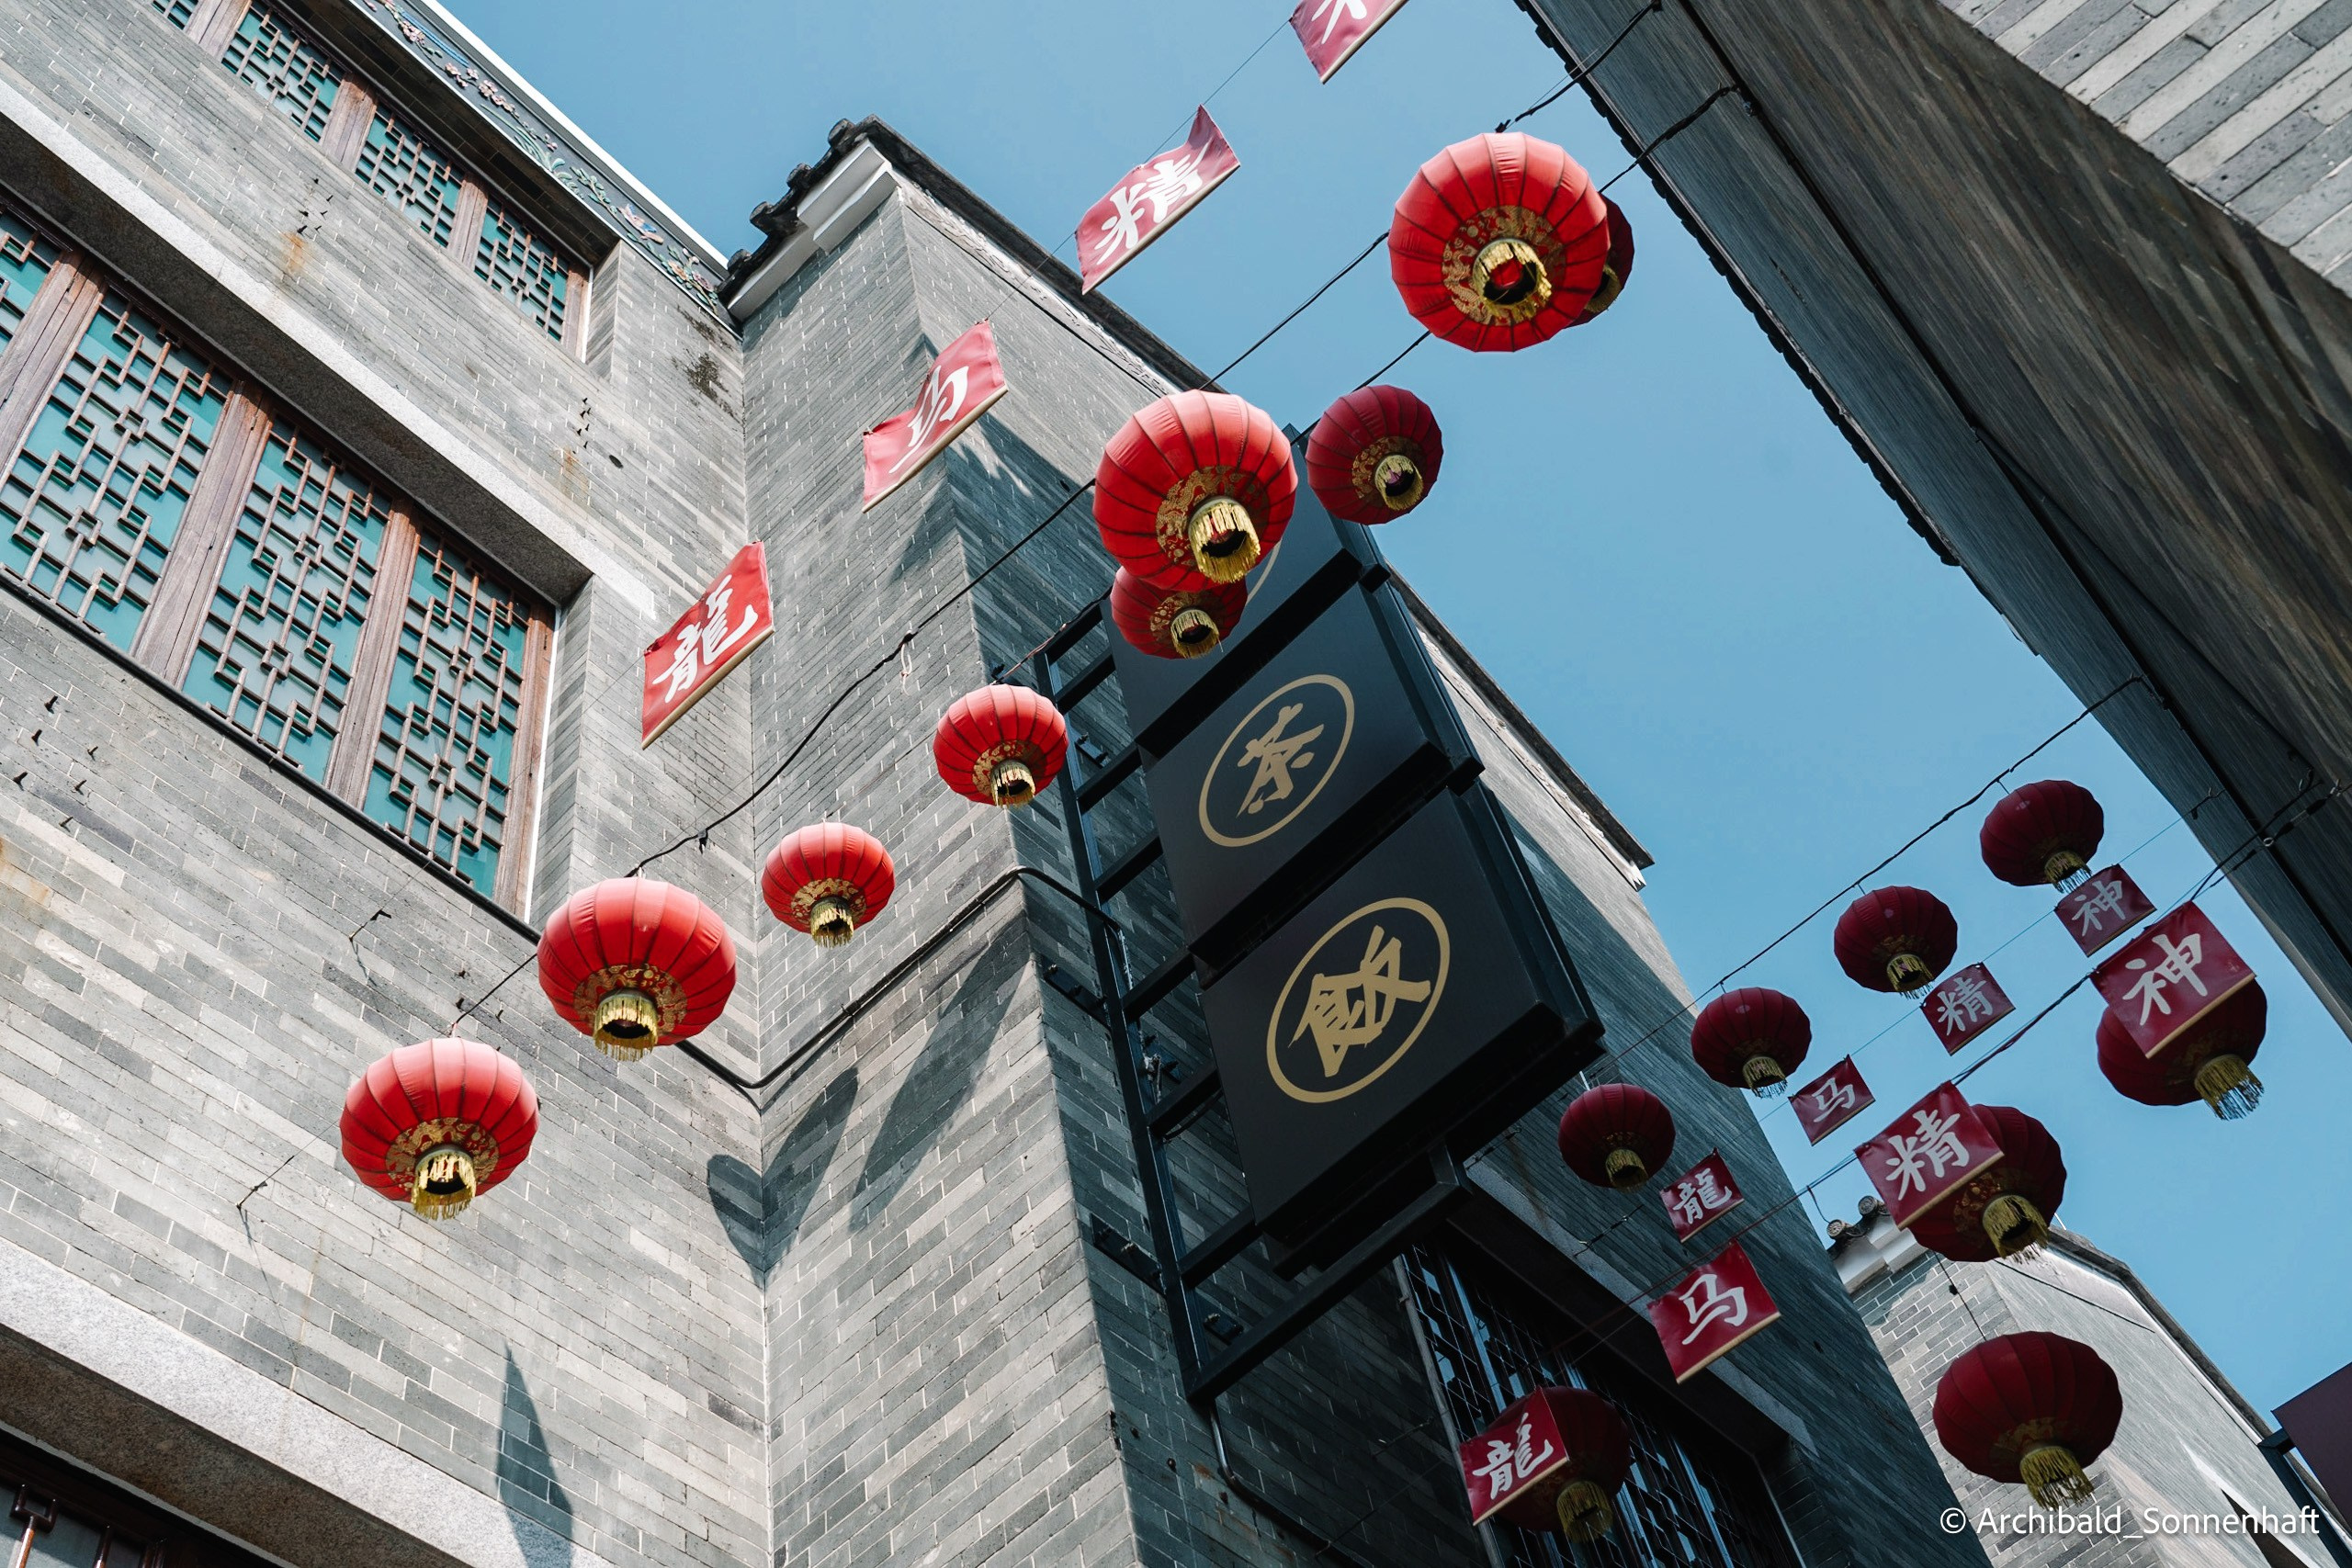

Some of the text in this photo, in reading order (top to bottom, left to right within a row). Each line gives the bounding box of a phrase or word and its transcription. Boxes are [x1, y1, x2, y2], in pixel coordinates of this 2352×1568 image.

[1094, 141, 1211, 265] 精
[652, 574, 759, 703] 龍
[1237, 703, 1325, 818] 茶
[2071, 879, 2124, 937] 神
[1936, 975, 1995, 1033] 精
[2122, 932, 2209, 1027] 神
[1813, 1077, 1856, 1122] 马
[1672, 1168, 1733, 1225] 龍
[1885, 1108, 1971, 1201] 精
[1679, 1272, 1748, 1346] 马
[1472, 1412, 1555, 1500] 龍
